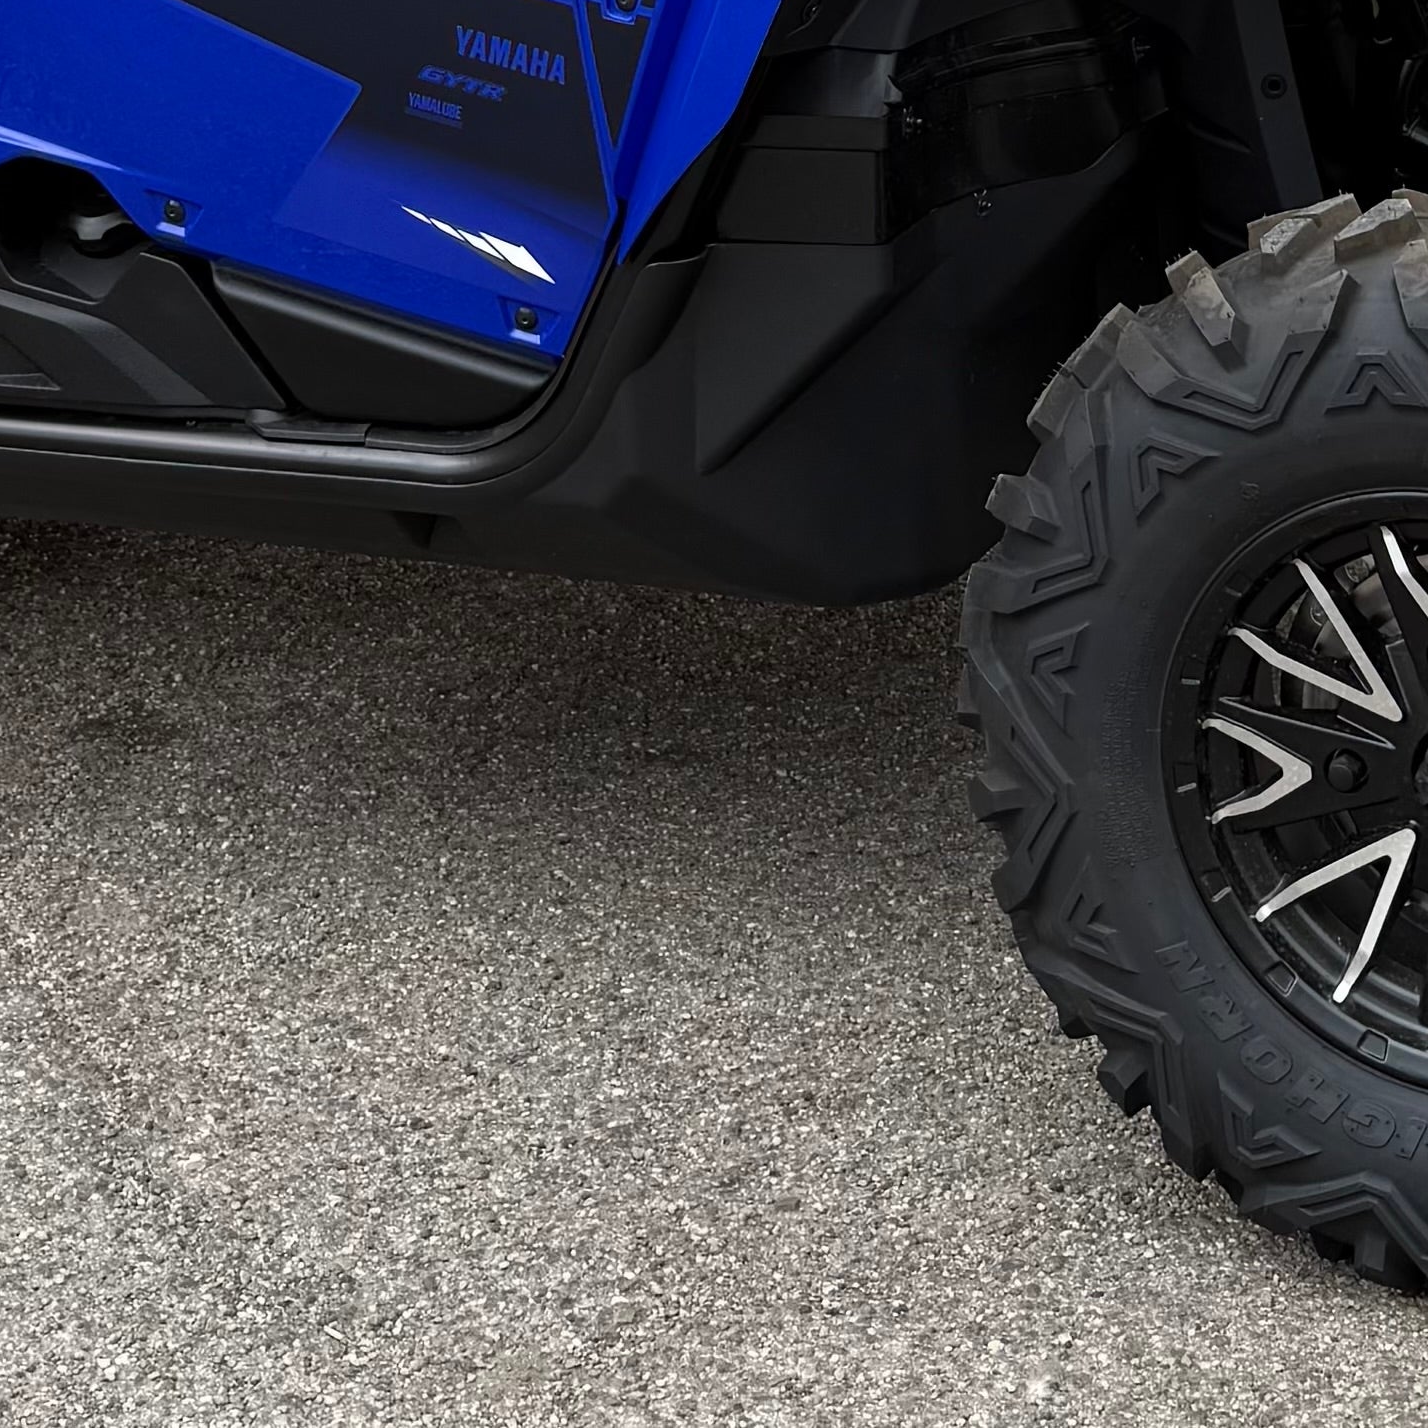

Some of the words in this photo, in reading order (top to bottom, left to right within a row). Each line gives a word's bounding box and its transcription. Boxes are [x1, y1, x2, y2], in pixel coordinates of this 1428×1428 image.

[456, 25, 565, 86] YAMAHA
[417, 64, 507, 102] GYTR
[408, 91, 464, 121] YAMALUBE
